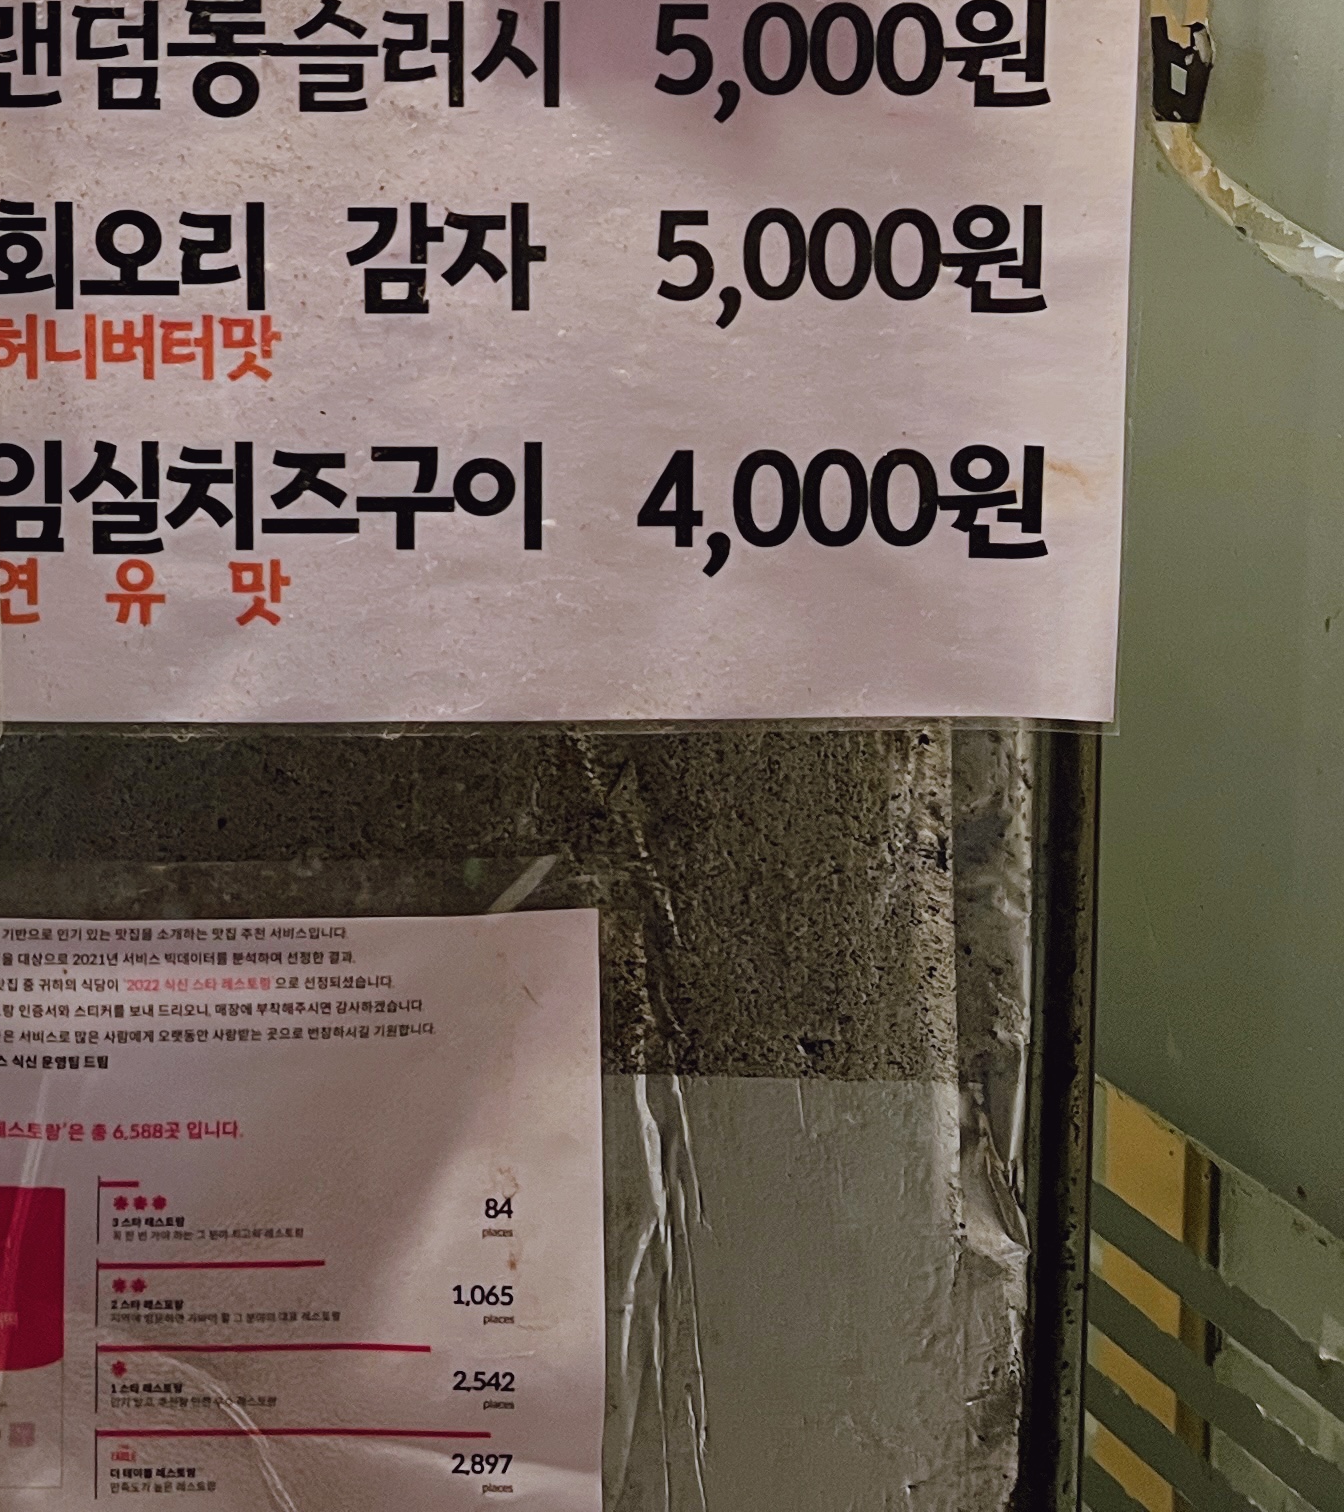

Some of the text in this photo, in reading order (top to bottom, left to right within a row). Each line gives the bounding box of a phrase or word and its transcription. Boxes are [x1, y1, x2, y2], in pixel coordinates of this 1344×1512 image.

[345, 201, 547, 315] 감자
[657, 204, 1048, 330] 5,000원
[636, 444, 1049, 578] 4,000원
[484, 1196, 514, 1219] 84
[481, 1227, 514, 1240] places
[452, 1284, 514, 1307] 1,065
[482, 1314, 515, 1326] places
[452, 1370, 516, 1393] 2,542
[482, 1399, 515, 1411] places
[451, 1452, 514, 1476] 2,897
[479, 1482, 514, 1498] places
